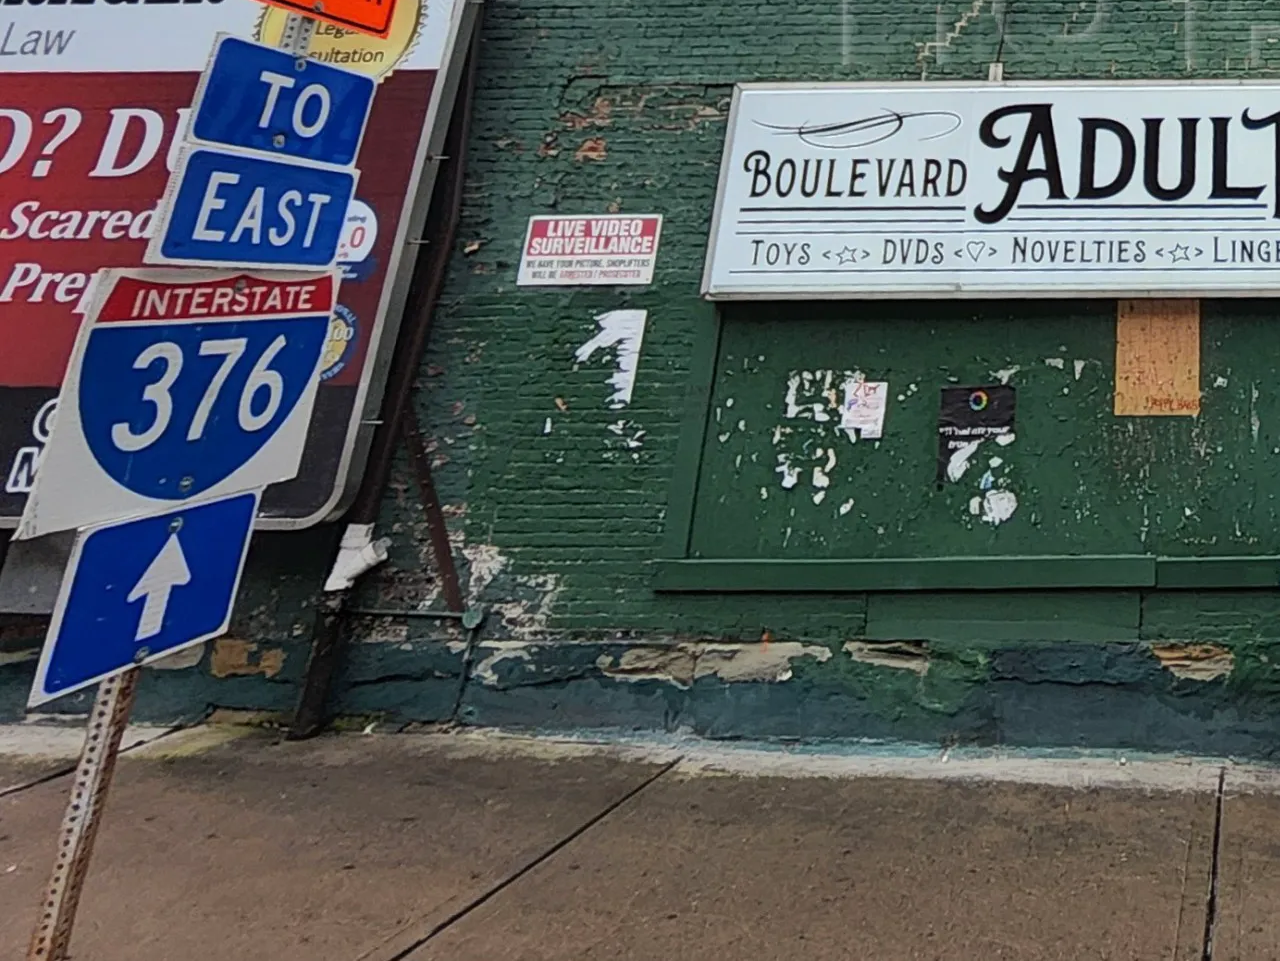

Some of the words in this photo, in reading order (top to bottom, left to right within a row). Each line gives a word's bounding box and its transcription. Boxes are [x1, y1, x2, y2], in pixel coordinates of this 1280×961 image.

[0, 21, 77, 55] Law
[259, 71, 331, 138] TO
[743, 150, 967, 198] BOULEVARD
[1, 200, 160, 240] Scared
[192, 170, 331, 248] EAST
[530, 236, 653, 254] SURVEILLANCE
[547, 220, 585, 237] LIVE
[590, 220, 643, 236] VIDEO
[751, 239, 811, 266] TOYS
[1011, 236, 1147, 264] NOVELTIES
[130, 284, 317, 318] INTERSTATE
[111, 334, 287, 452] 376
